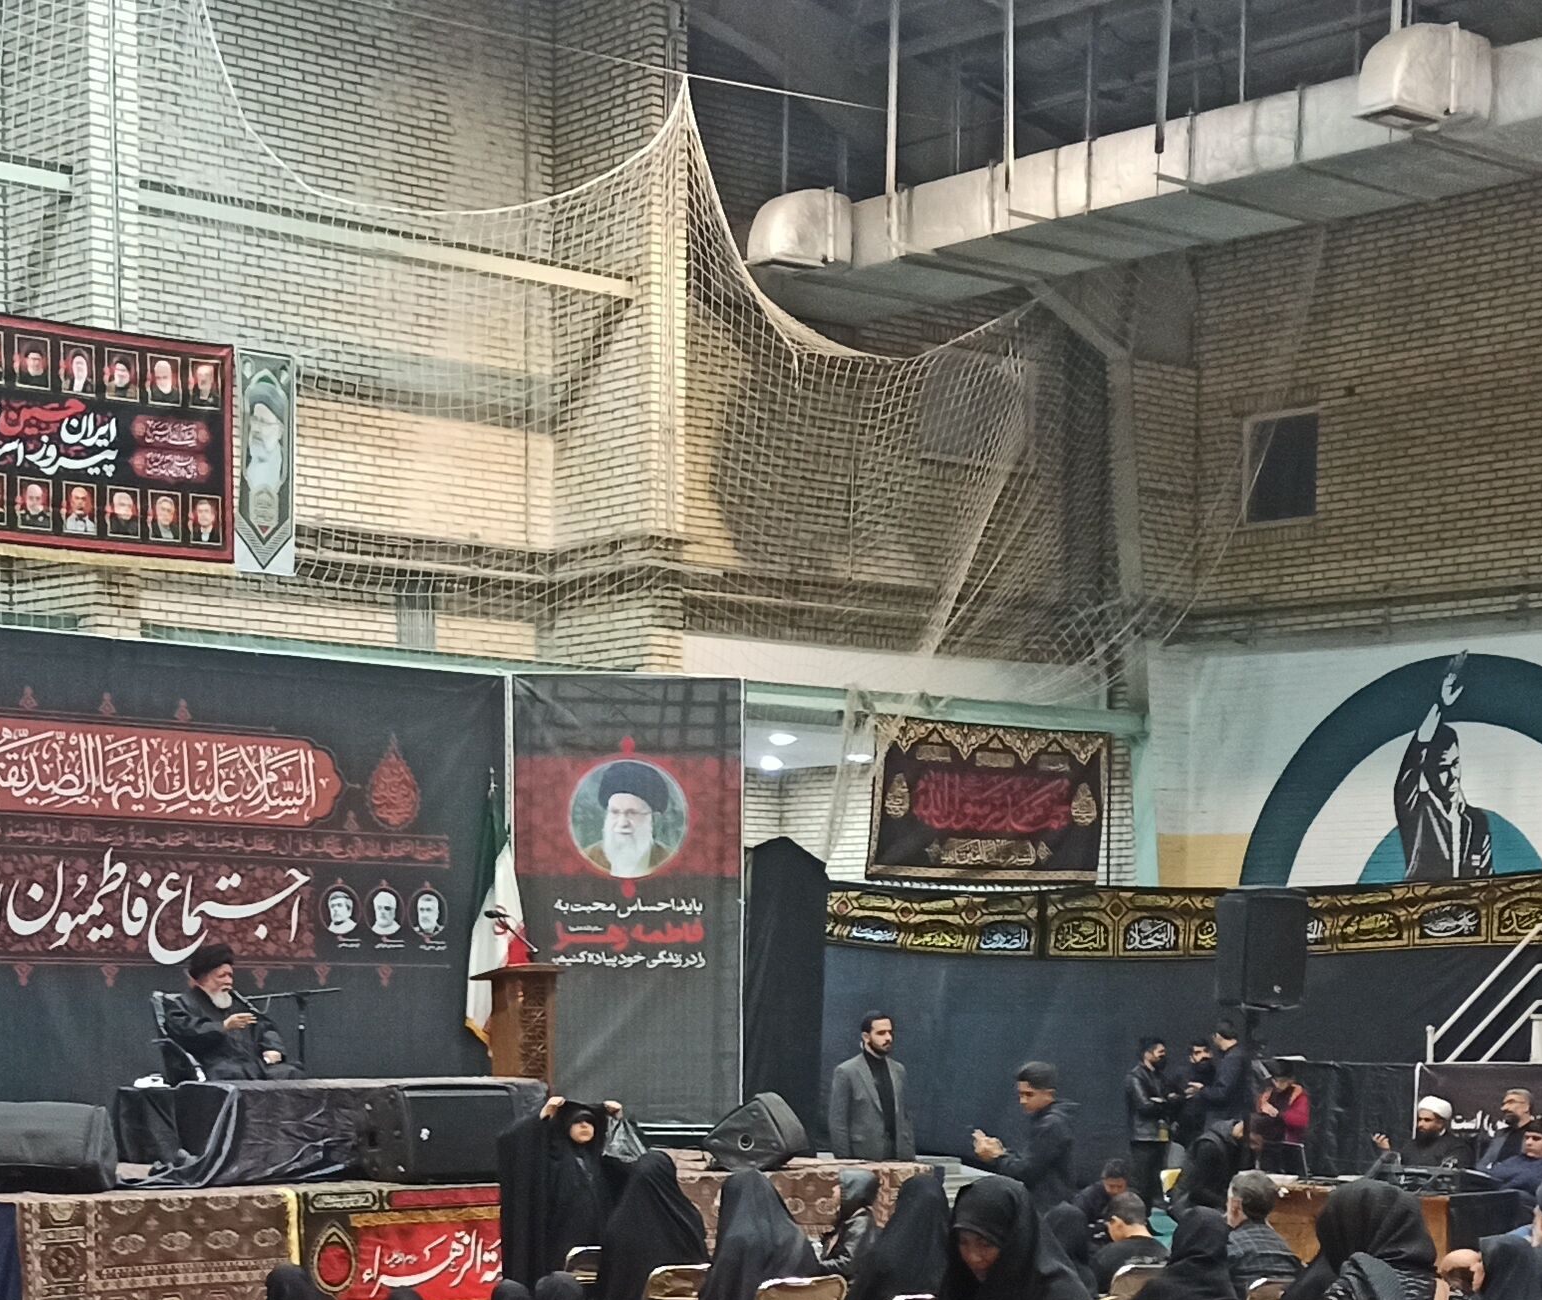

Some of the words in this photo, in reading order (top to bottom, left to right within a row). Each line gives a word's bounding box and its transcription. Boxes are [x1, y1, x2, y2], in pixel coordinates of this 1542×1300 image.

[60, 412, 117, 447] ایران
[25, 435, 118, 477] پیروز
[148, 867, 311, 965] اجتماع
[570, 900, 617, 914] محبت
[617, 898, 676, 918] احساس
